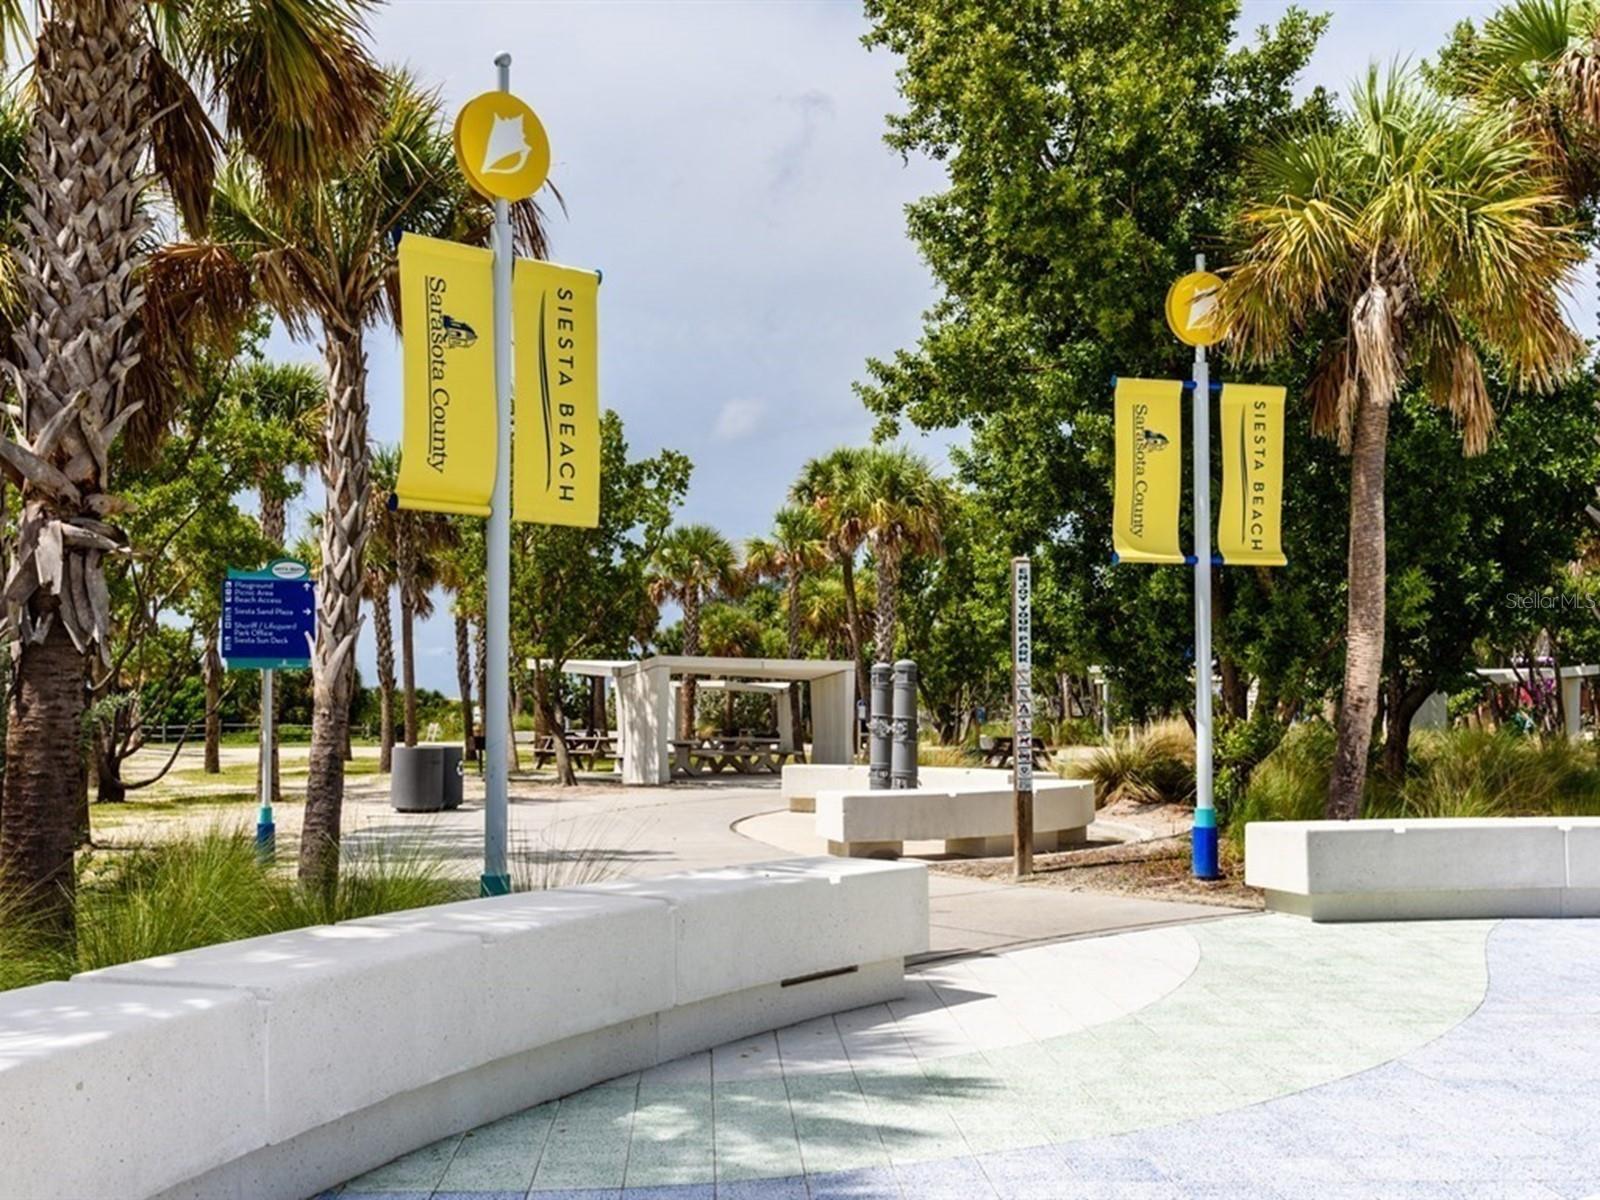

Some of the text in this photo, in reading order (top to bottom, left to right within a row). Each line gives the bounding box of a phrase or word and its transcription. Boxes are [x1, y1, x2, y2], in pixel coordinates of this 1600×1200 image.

[427, 277, 450, 473] Sarasota County
[557, 287, 576, 501] SIESTA BEACH
[1130, 404, 1148, 538] Sarasota County
[1251, 401, 1266, 550] SIESTA BEACH
[1018, 568, 1028, 663] ENJOY YOUR PARK
